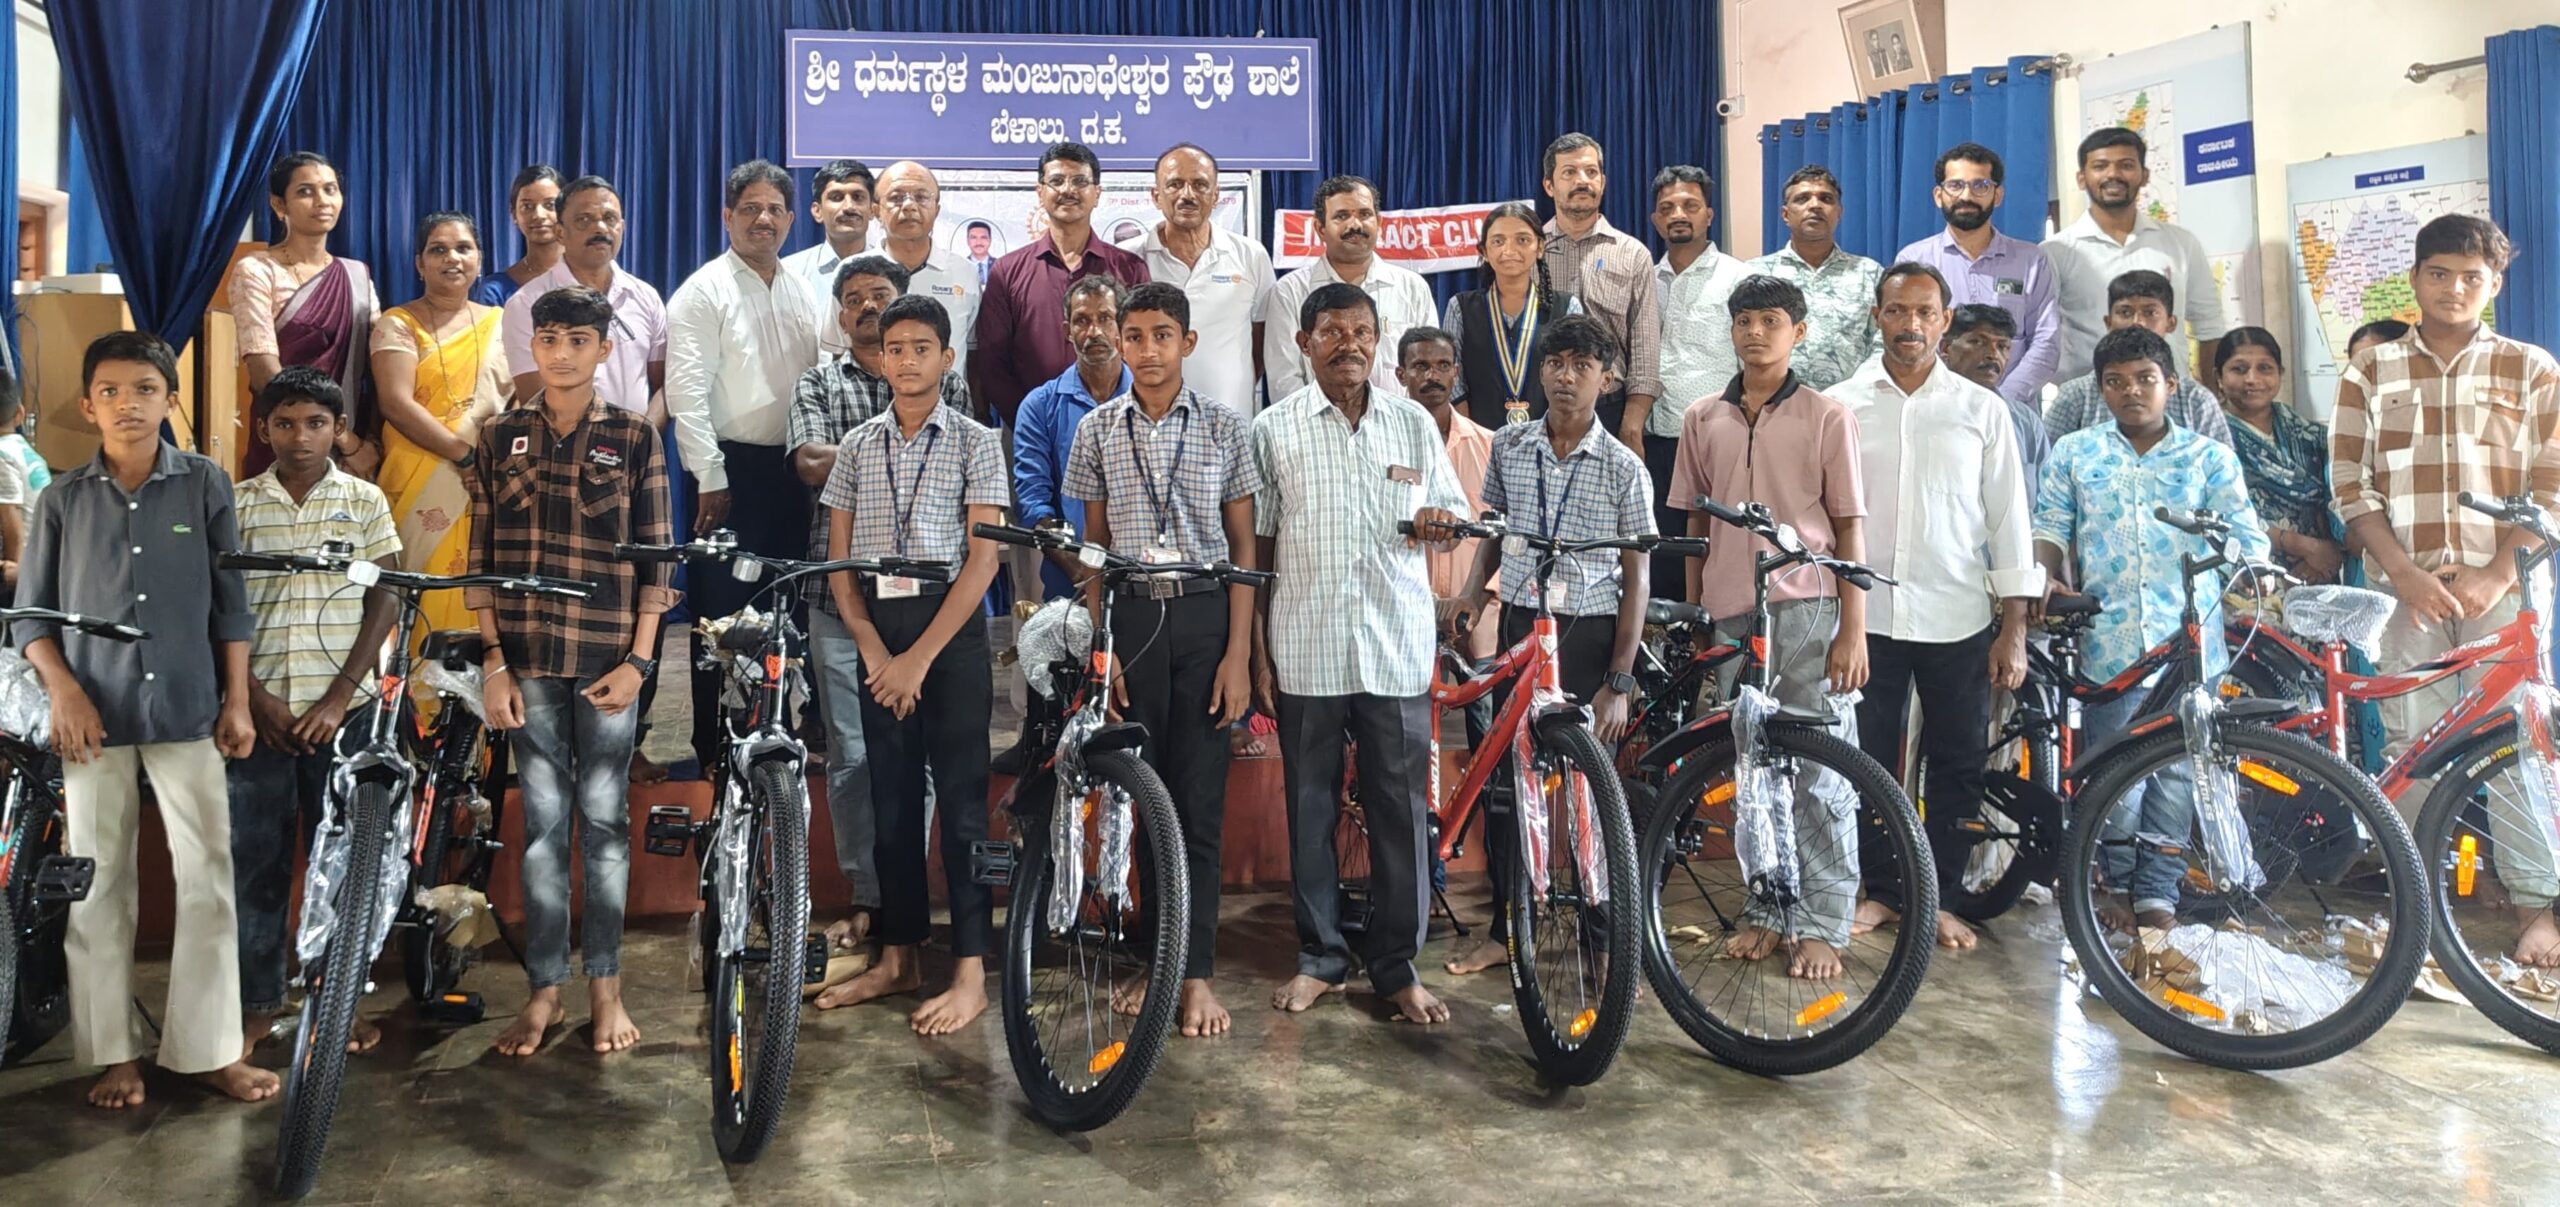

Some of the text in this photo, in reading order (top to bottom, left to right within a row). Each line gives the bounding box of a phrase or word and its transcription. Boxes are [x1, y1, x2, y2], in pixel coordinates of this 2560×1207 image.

[804, 50, 1301, 117] ಶ್ರೀ ಧರ್ಮಸ್ಥಳ ಮಂಜುನಾಥೇಶ್ವರ ಪ್ರೌಢ ಶಾಲೆ
[1080, 110, 1127, 144] ದ.ಕ.
[1430, 739, 1440, 809] STORM
